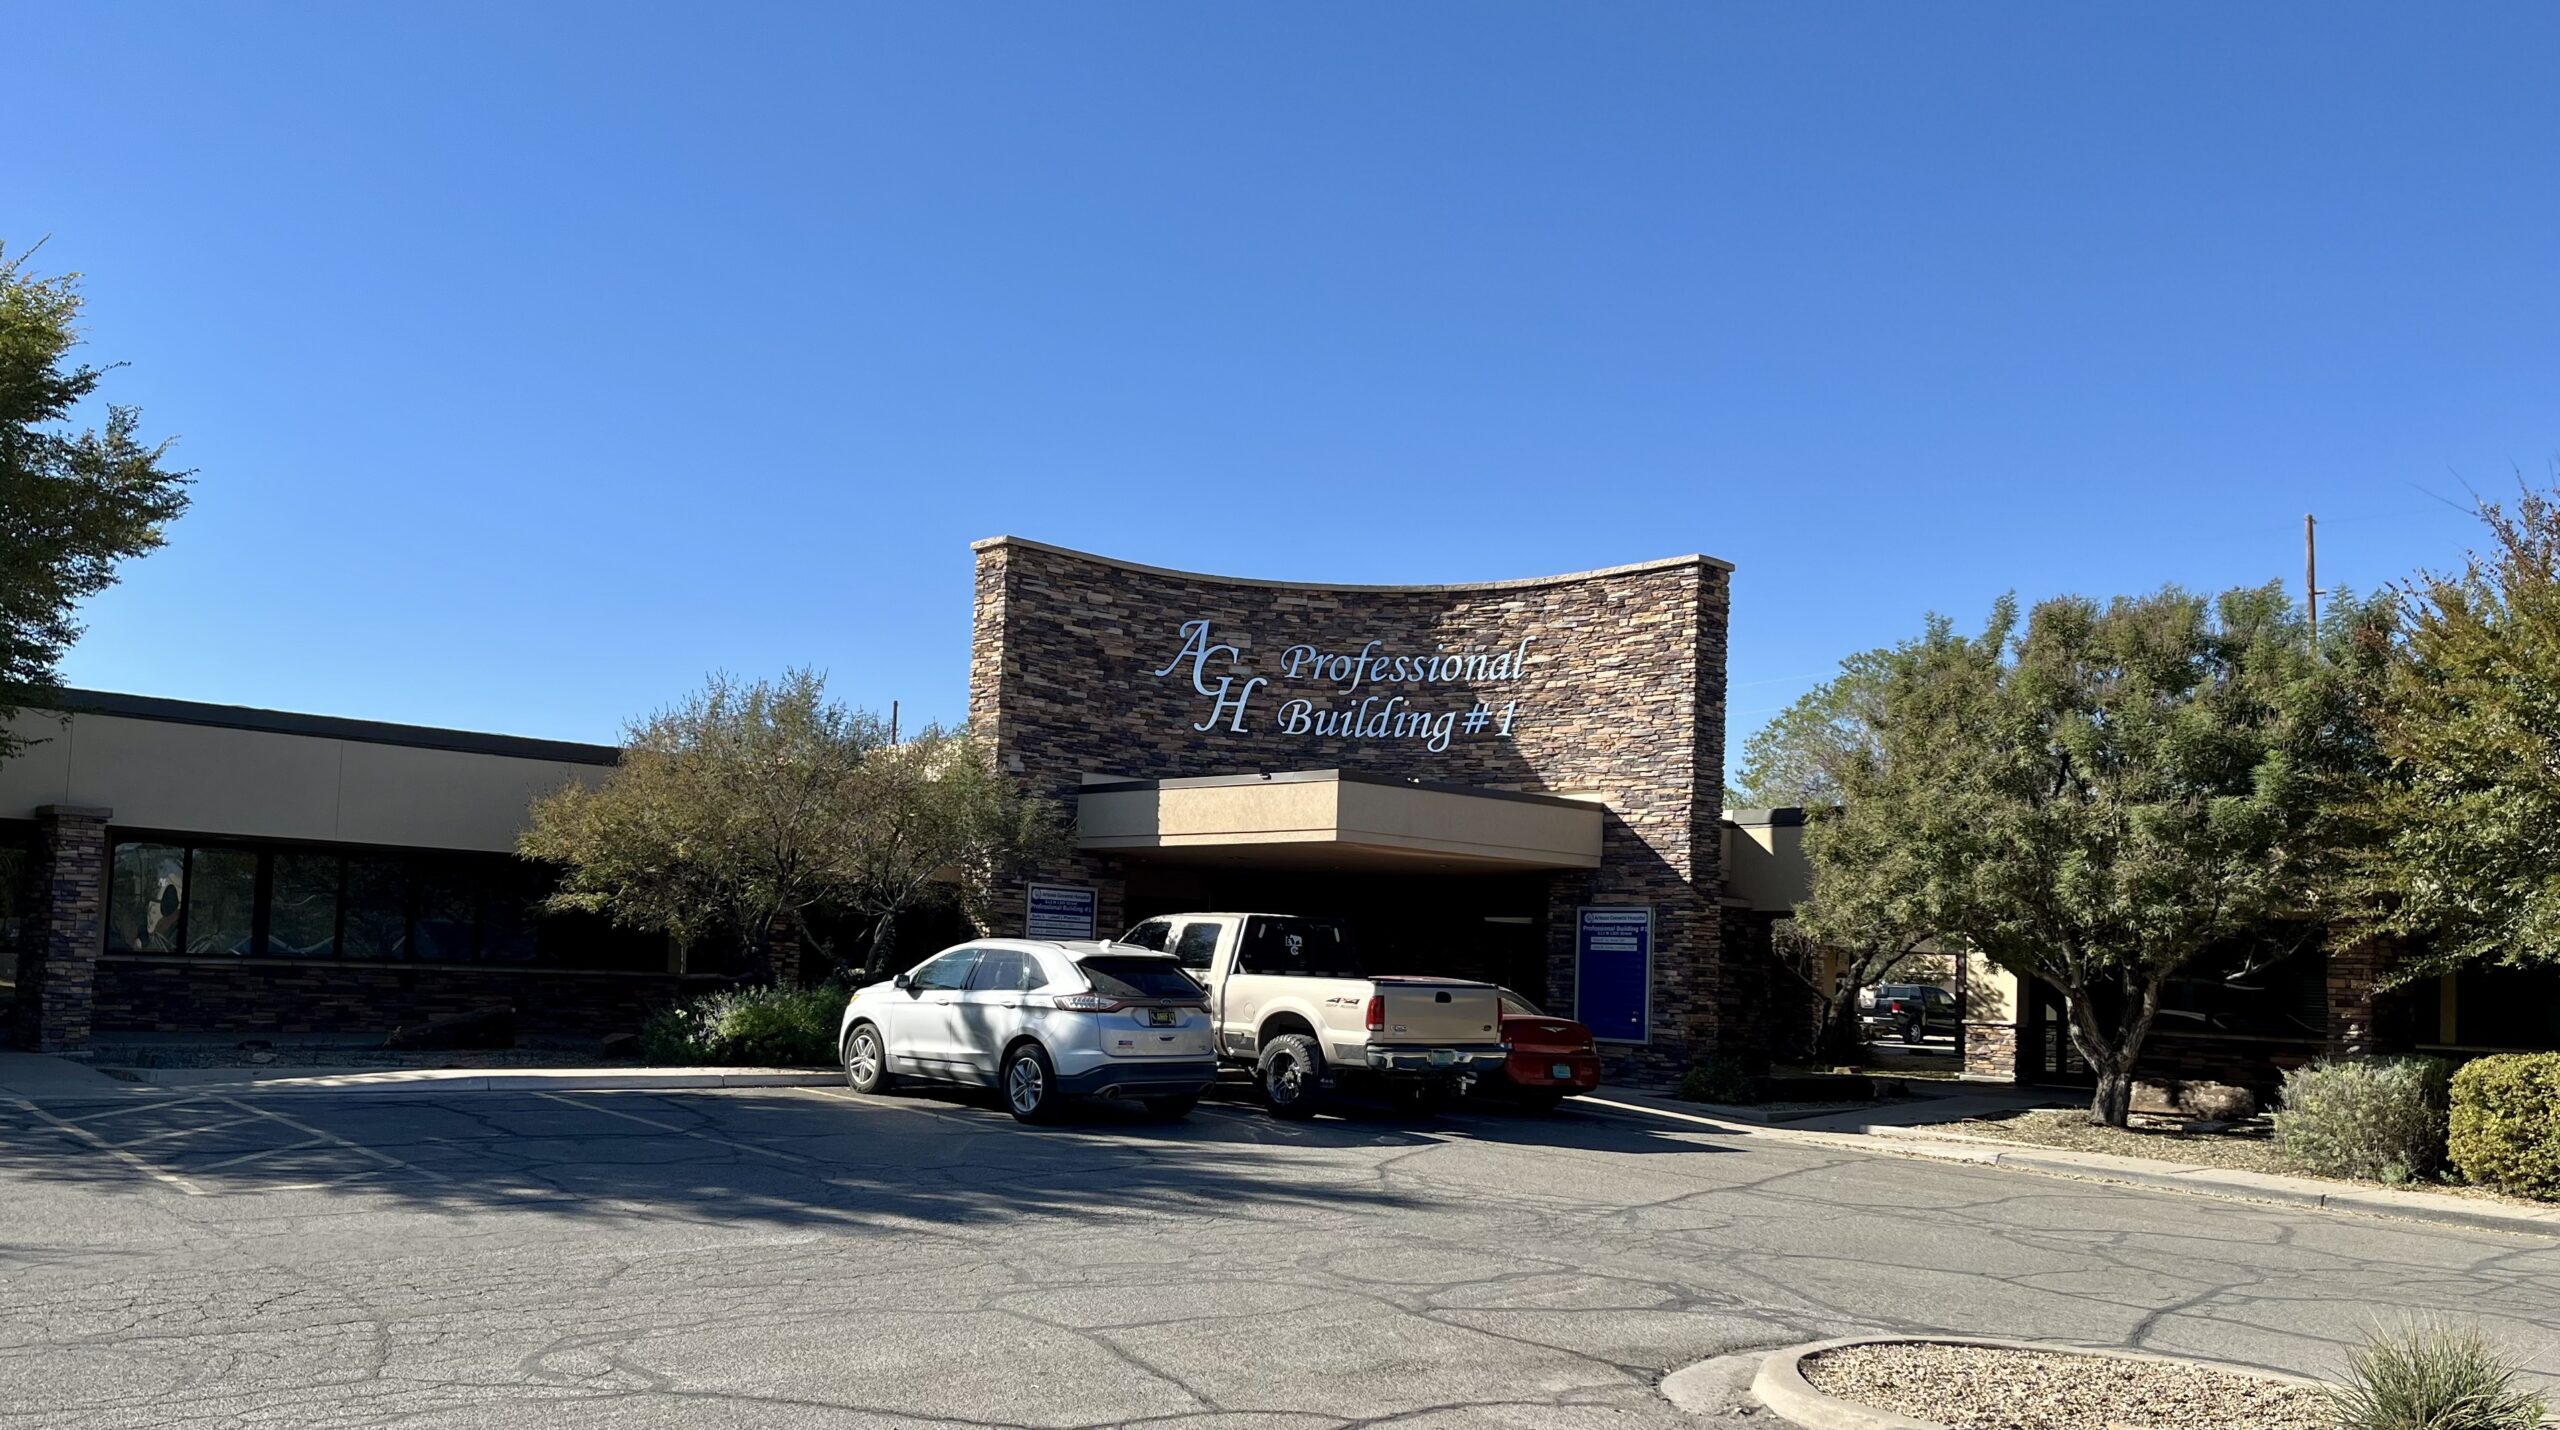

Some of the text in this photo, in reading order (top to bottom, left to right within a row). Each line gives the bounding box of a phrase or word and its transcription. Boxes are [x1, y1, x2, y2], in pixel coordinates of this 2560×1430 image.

[1154, 618, 1268, 733] AGH
[1280, 636, 1537, 695] Professional
[1277, 696, 1517, 752] Building #1
[1031, 902, 1062, 910] Professional
[1063, 905, 1084, 913] Building
[1616, 925, 1639, 933] Building
